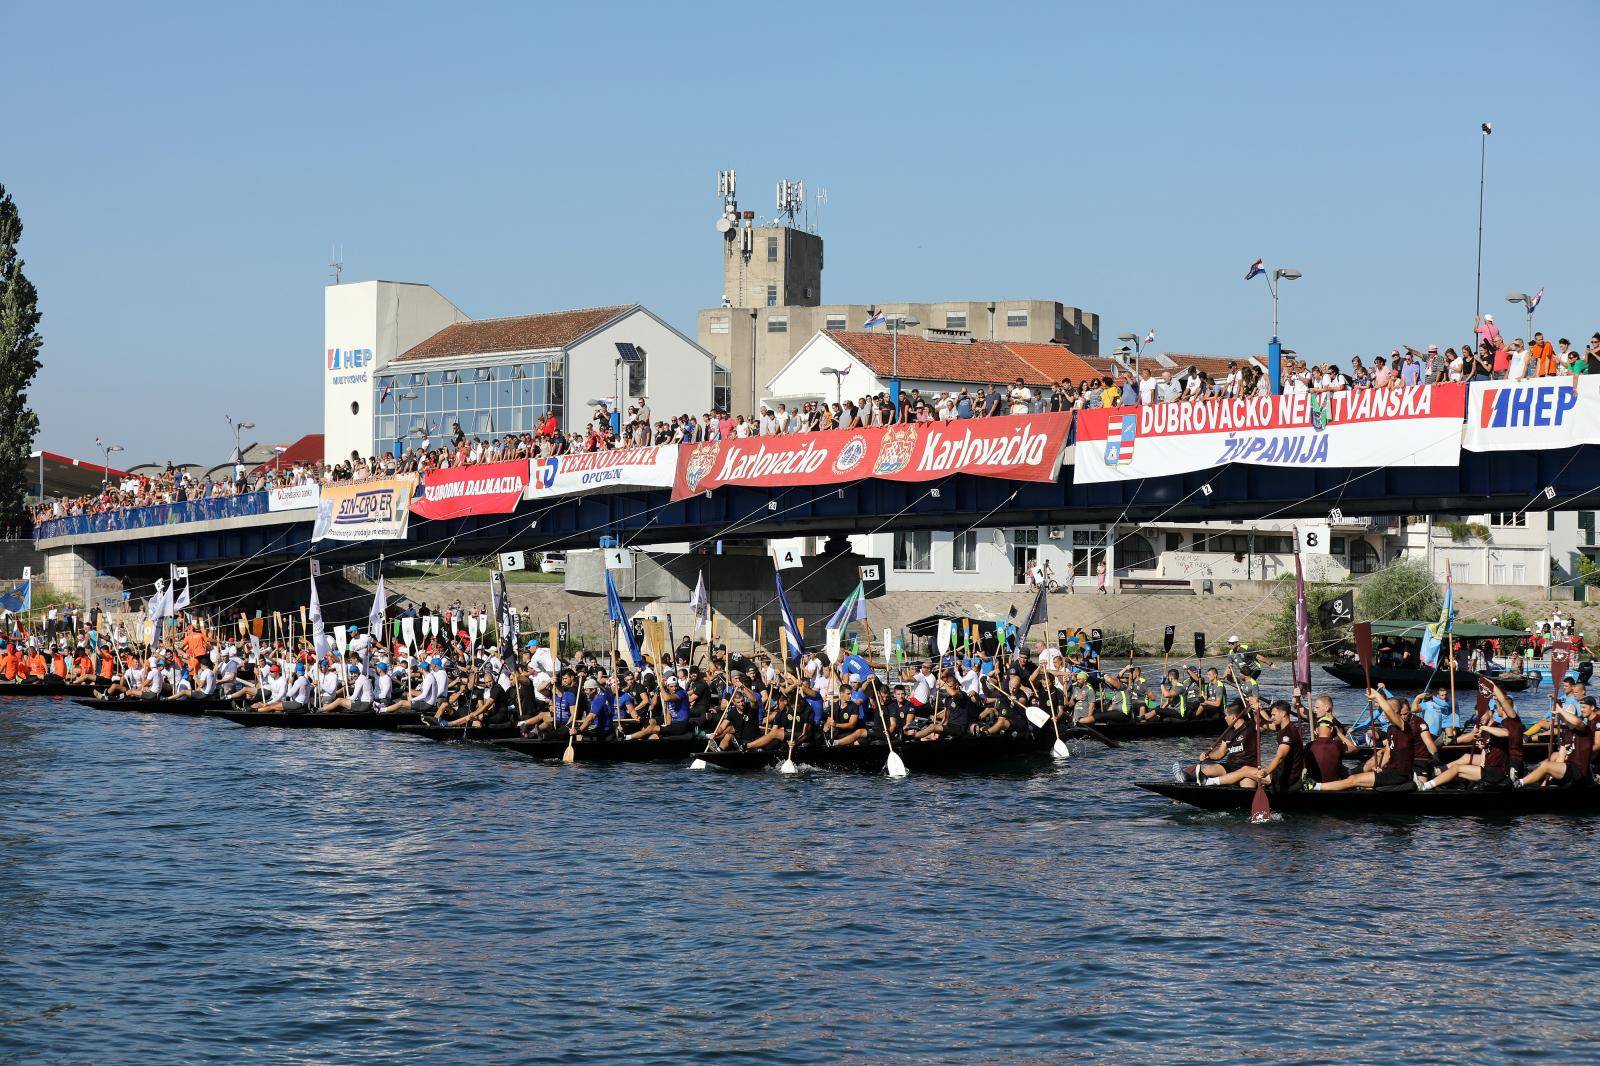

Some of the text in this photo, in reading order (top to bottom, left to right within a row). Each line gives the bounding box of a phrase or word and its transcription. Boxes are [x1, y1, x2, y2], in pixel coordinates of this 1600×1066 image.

[344, 349, 372, 369] HEP
[1278, 385, 1432, 425] NETVANSKA
[1511, 386, 1578, 427] HEP
[915, 422, 1048, 471] Karlovačko
[1215, 432, 1328, 465] ŽUPANIJA
[560, 446, 659, 474] TEHNODELTA
[714, 439, 828, 480] Karlovačko
[465, 476, 522, 496] DALMACIJA
[582, 469, 623, 484] OPUZEN
[1331, 509, 1342, 519] 15
[1307, 532, 1318, 547] 8
[507, 556, 515, 567] 3
[615, 553, 621, 564] 1
[785, 552, 794, 563] 4
[863, 569, 875, 578] 15
